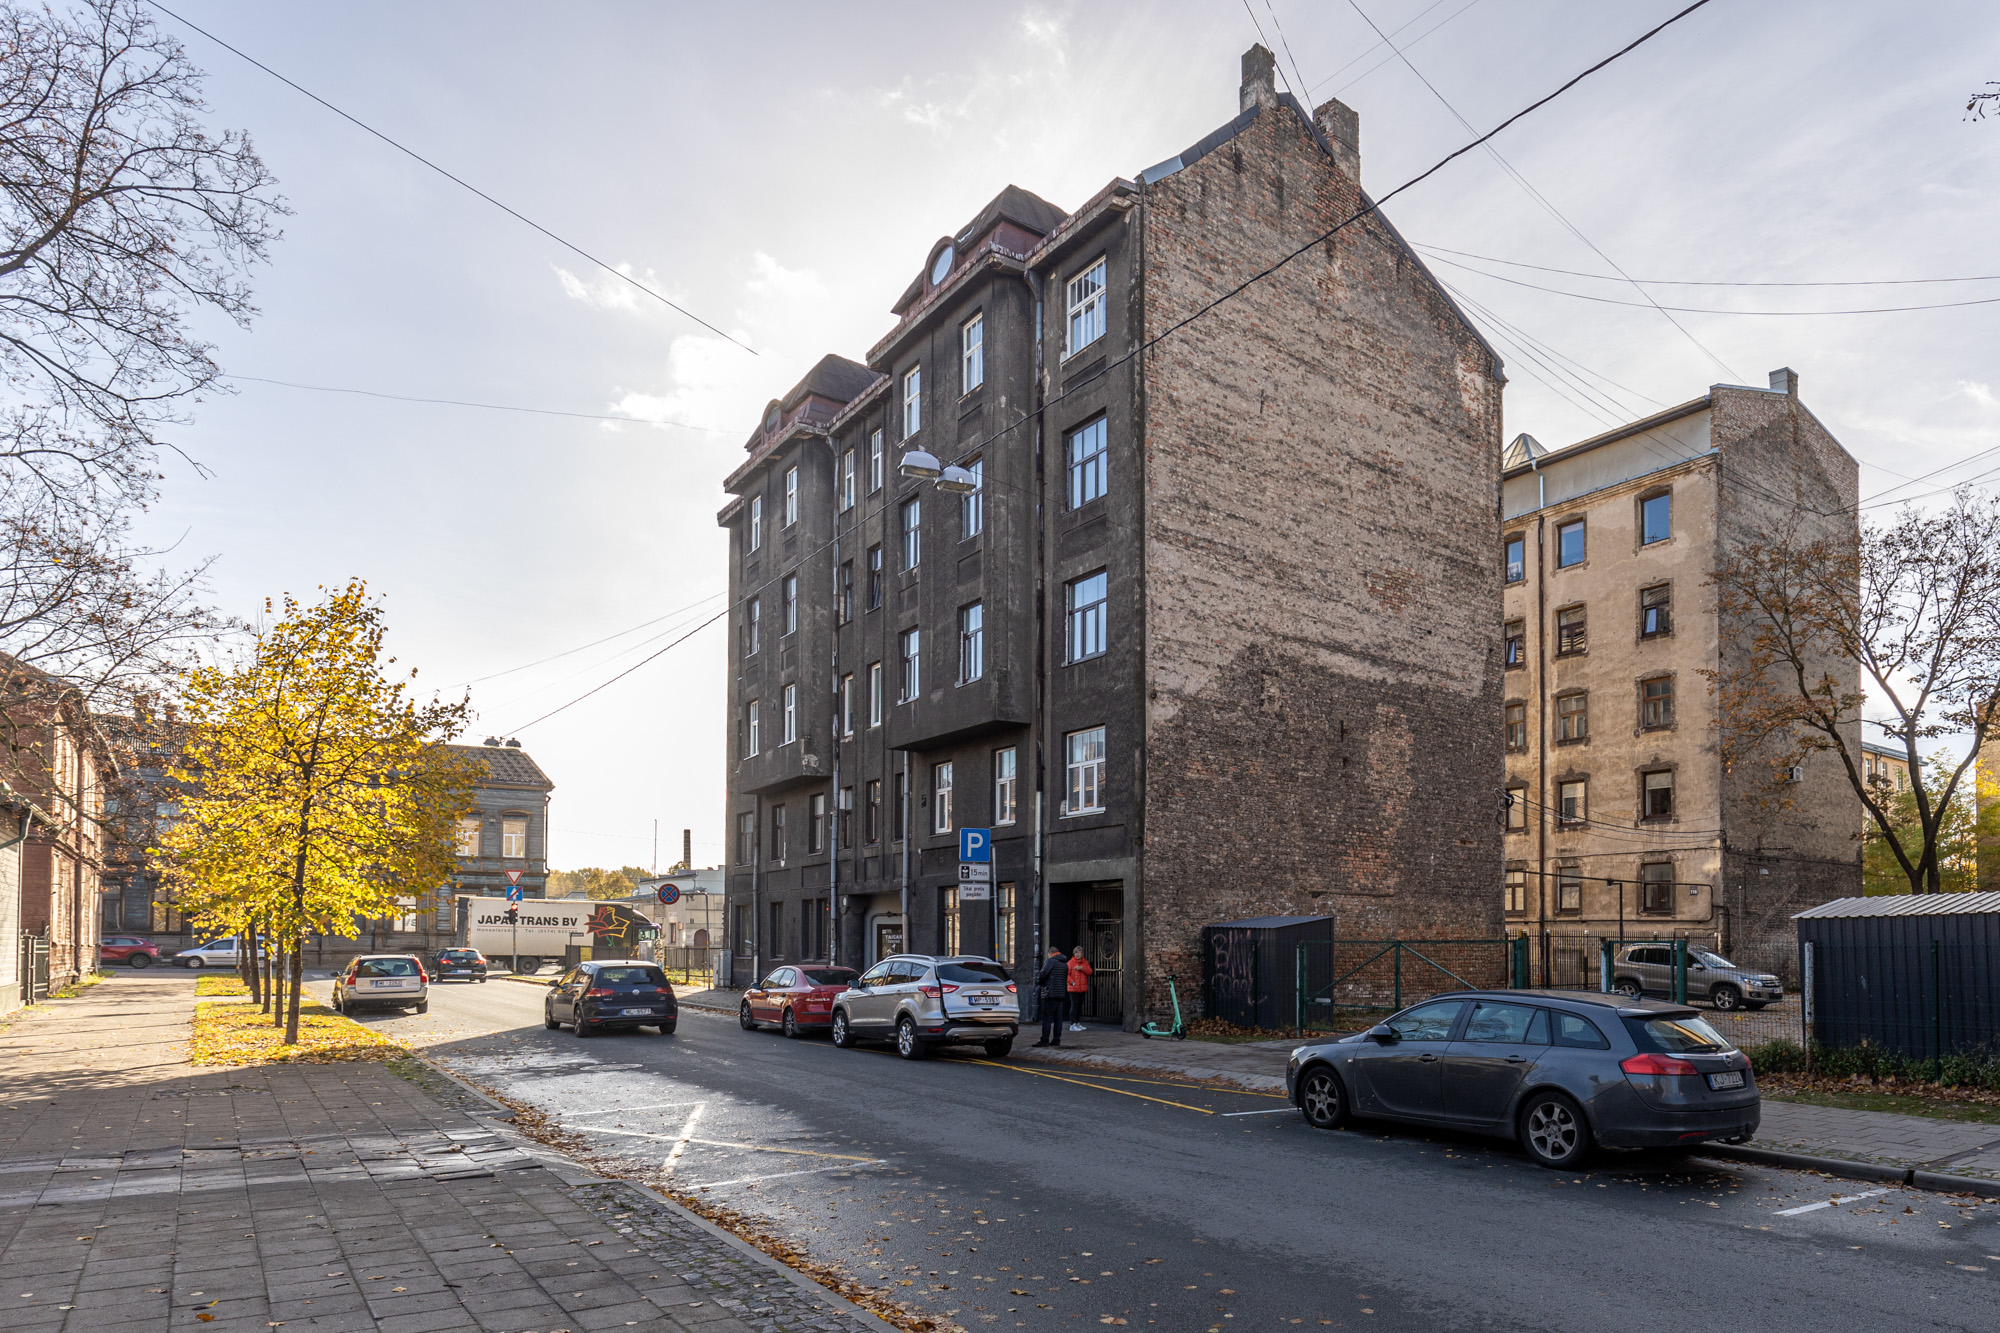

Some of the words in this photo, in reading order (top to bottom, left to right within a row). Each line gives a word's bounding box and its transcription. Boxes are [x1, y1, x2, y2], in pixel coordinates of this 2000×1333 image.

[967, 832, 984, 858] P
[478, 915, 517, 924] JAPA
[520, 916, 559, 926] TRANS
[562, 918, 578, 926] BV
